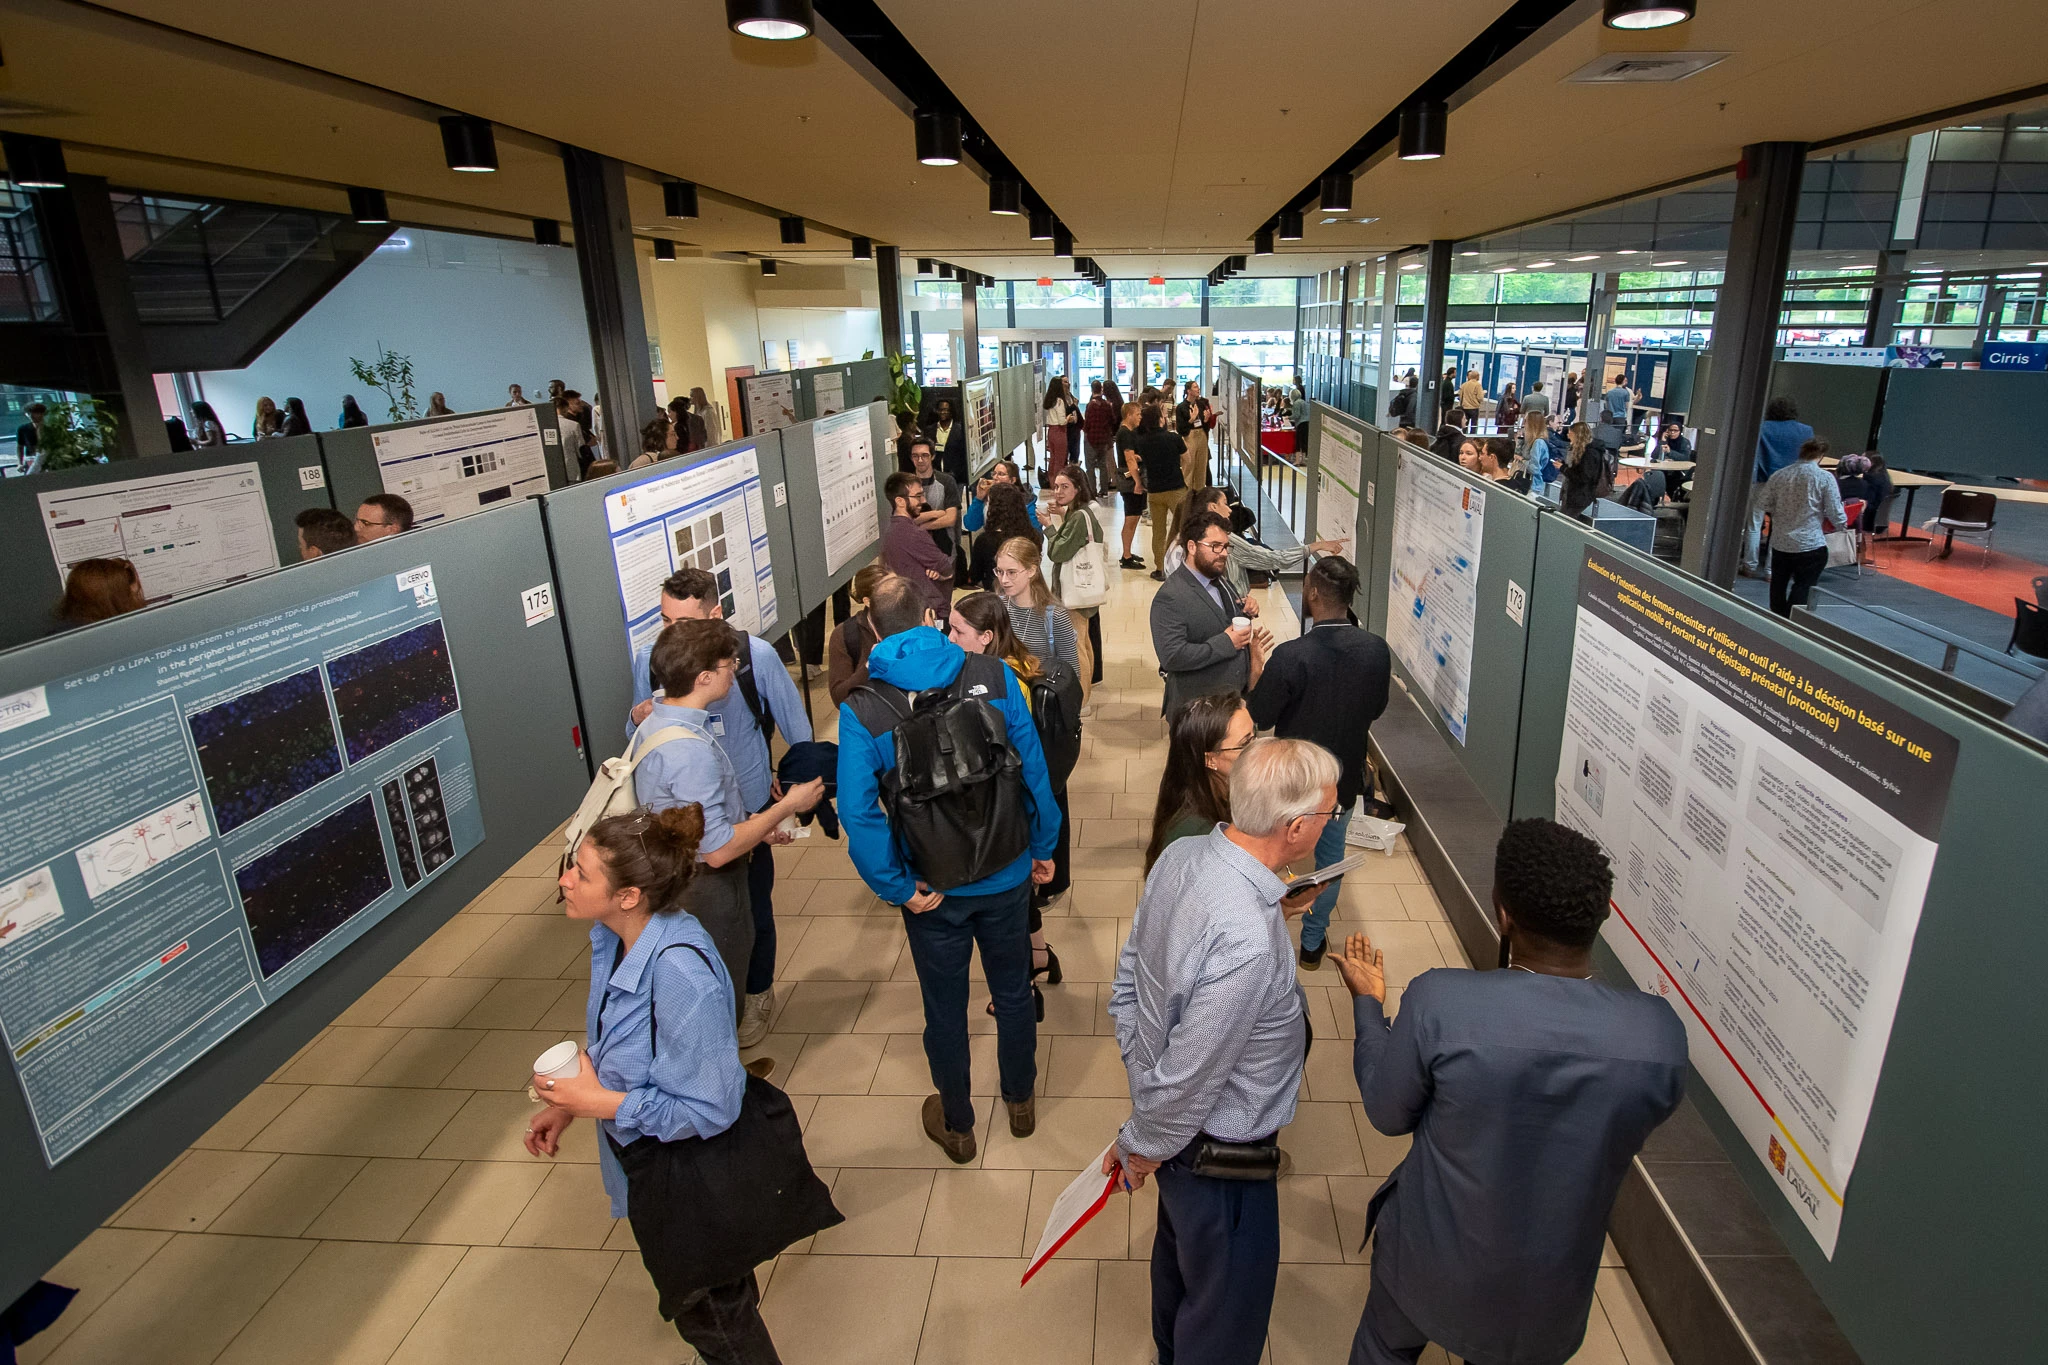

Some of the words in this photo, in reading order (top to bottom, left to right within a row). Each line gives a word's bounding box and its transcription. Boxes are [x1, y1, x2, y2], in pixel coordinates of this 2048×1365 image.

[1990, 353, 2029, 364] Cirris
[303, 469, 320, 480] 188
[775, 487, 784, 497] 176
[407, 570, 429, 583] CERVO
[527, 590, 548, 610] 175
[1510, 587, 1523, 610] 173
[63, 676, 82, 689] Set
[86, 672, 100, 684] up
[102, 666, 115, 677] of
[189, 632, 222, 651] system
[224, 629, 234, 638] to
[236, 614, 282, 635] investigate
[310, 590, 360, 612] proteinopathy
[157, 663, 168, 674] in
[169, 657, 186, 669] the
[187, 642, 234, 665] peripheral
[236, 632, 269, 647] nervous
[271, 619, 302, 637] system.
[1618, 593, 1644, 612] application
[1646, 610, 1664, 624] mobile
[1671, 623, 1696, 642] portant
[1697, 640, 1708, 649] sur
[1710, 644, 1716, 654] le
[1716, 650, 1751, 676] dépistage
[1751, 672, 1786, 697] prénatal
[1787, 690, 1839, 732] (protocole)
[1642, 591, 1651, 601] des
[1652, 597, 1674, 614] femmes
[1675, 612, 1706, 632] enceintes
[1738, 647, 1748, 656] un
[1750, 653, 1769, 668] outil
[1770, 662, 1795, 684] d'aide
[1796, 678, 1803, 688] à
[1804, 681, 1813, 694] la
[1815, 689, 1856, 718] décision
[1858, 710, 1884, 735] basé
[1886, 730, 1906, 746] sur
[1908, 742, 1931, 762] une
[1881, 777, 1901, 797] Sylvie
[1794, 779, 1814, 798] Collecte
[1814, 794, 1824, 806] des
[1824, 801, 1848, 823] données
[72, 1033, 87, 1047] and
[1787, 1168, 1818, 1220] LAVAL
